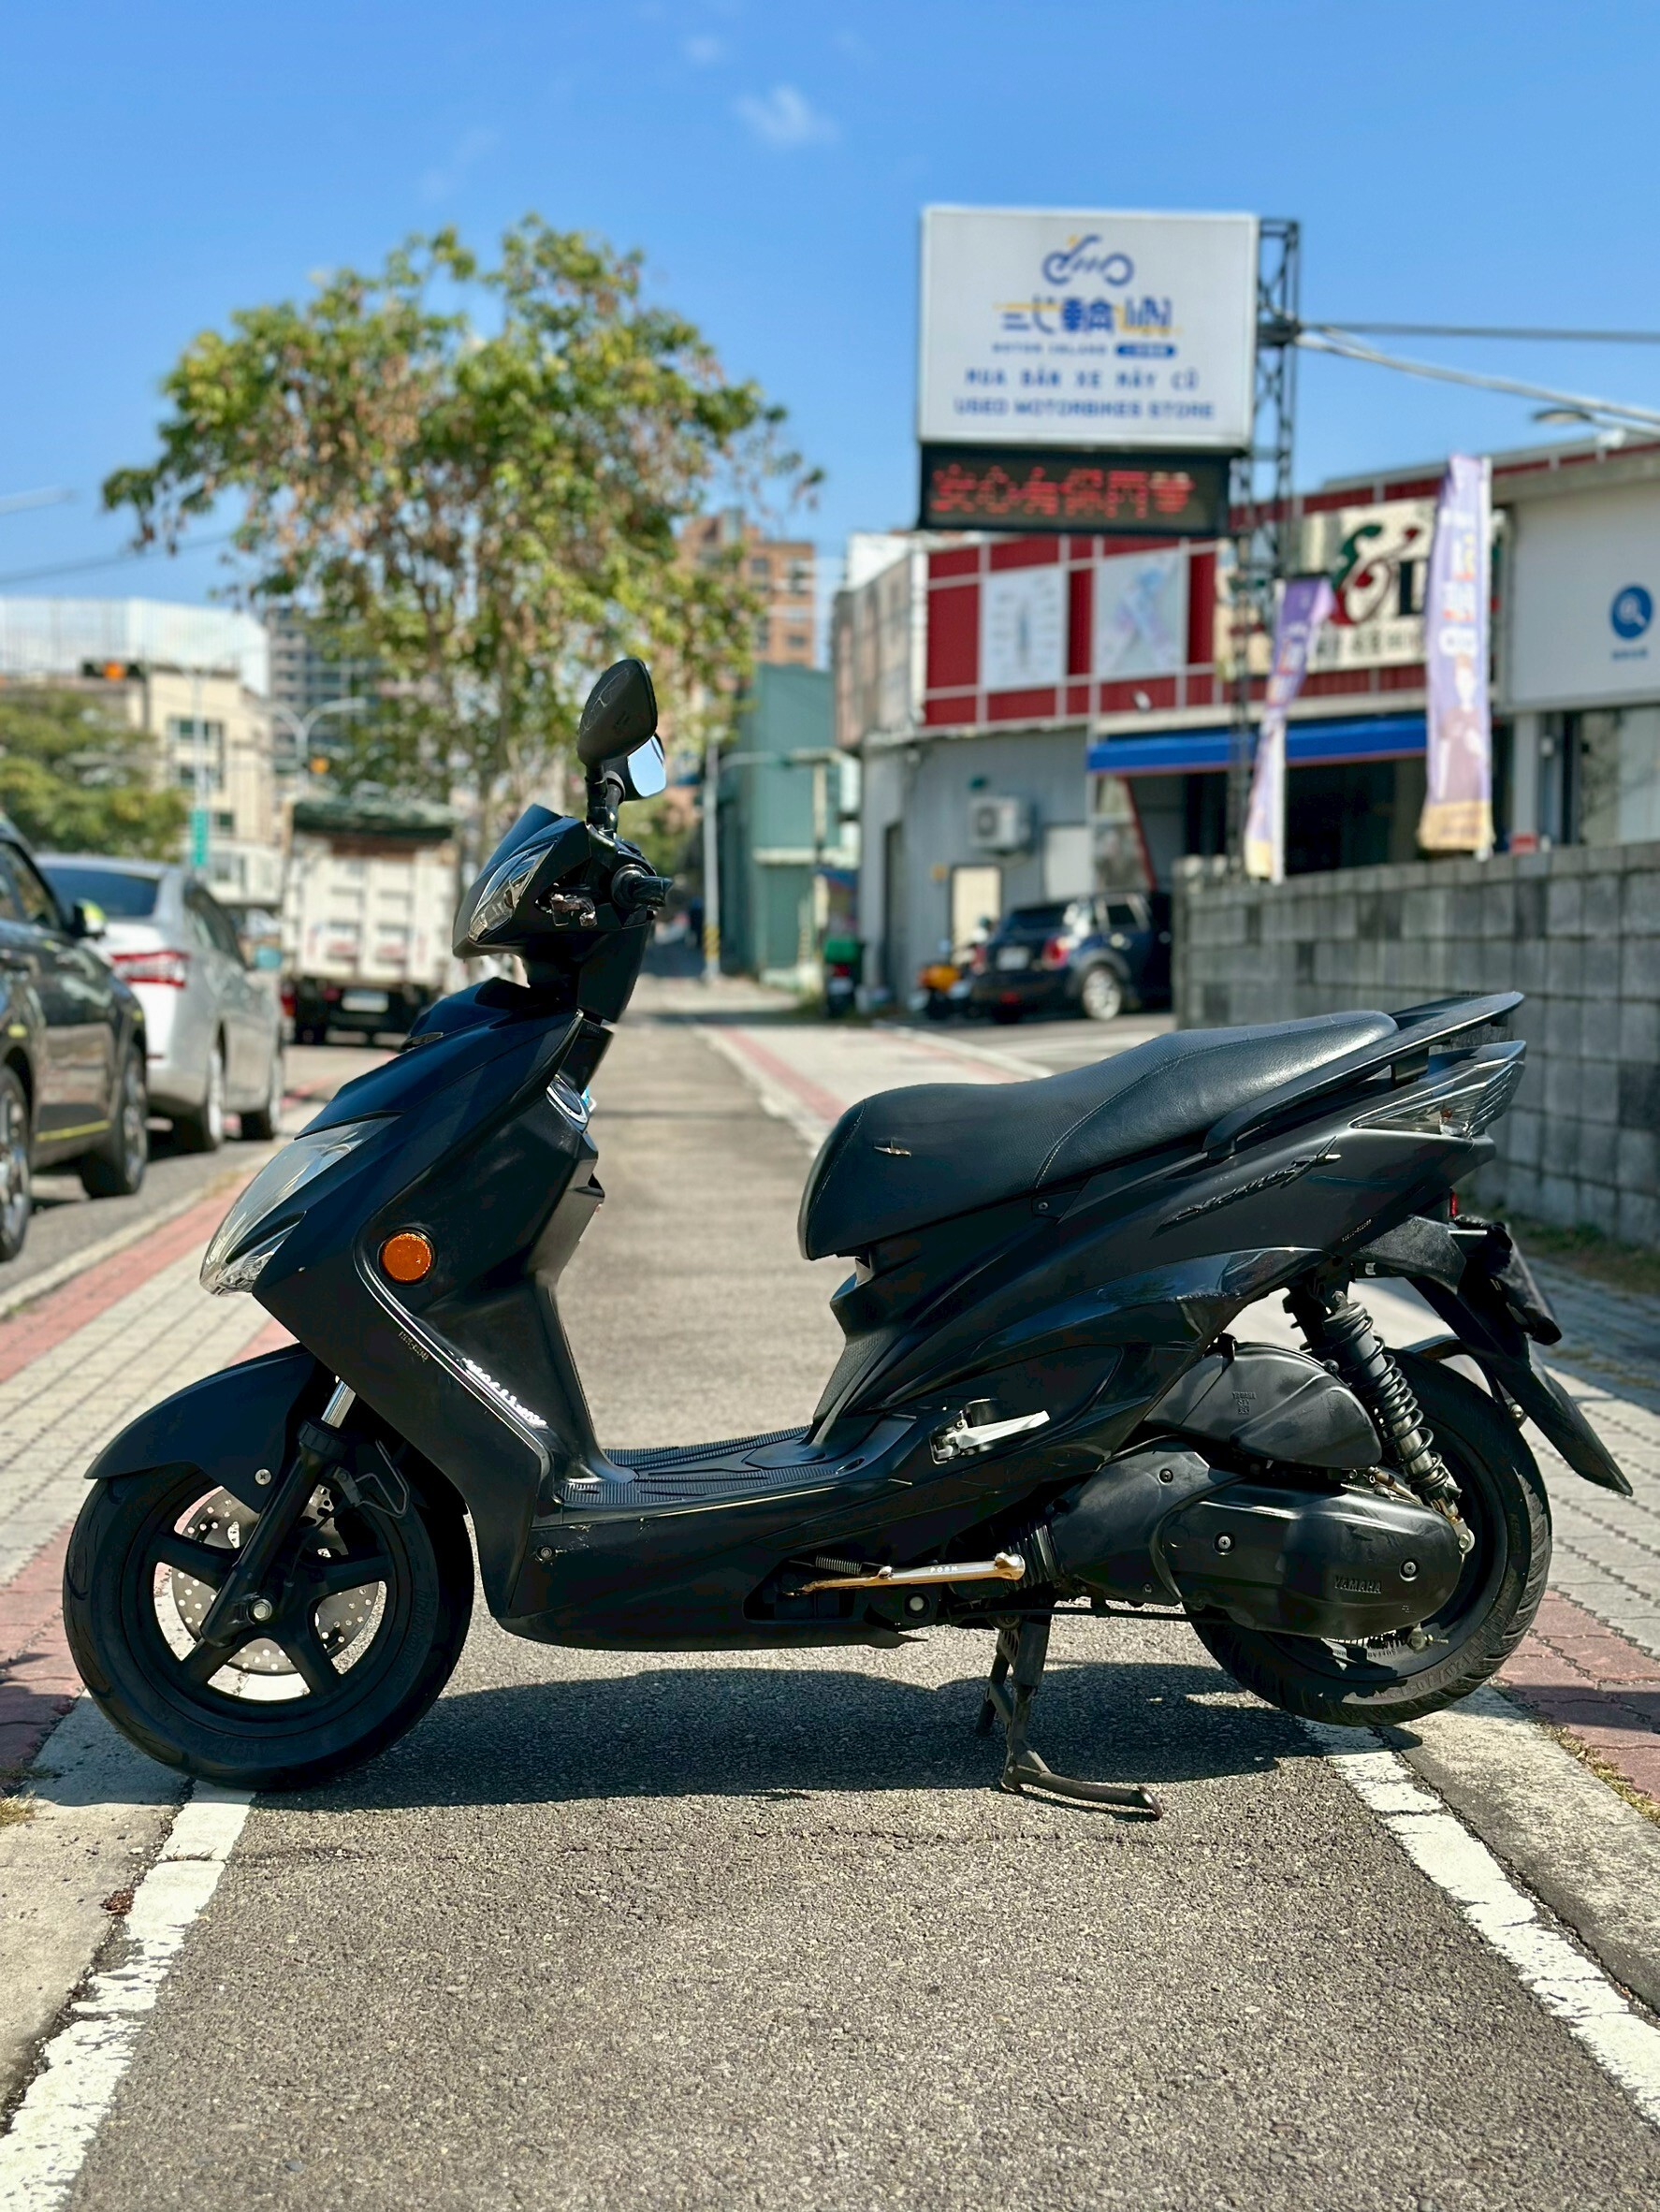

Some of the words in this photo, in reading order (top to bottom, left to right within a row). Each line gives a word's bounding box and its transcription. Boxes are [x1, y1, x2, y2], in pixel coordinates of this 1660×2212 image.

[954, 399, 1009, 415] USED
[1014, 400, 1143, 418] MOTORBIKES
[1148, 401, 1215, 420] STORE
[1334, 1576, 1381, 1594] YAMAHA
